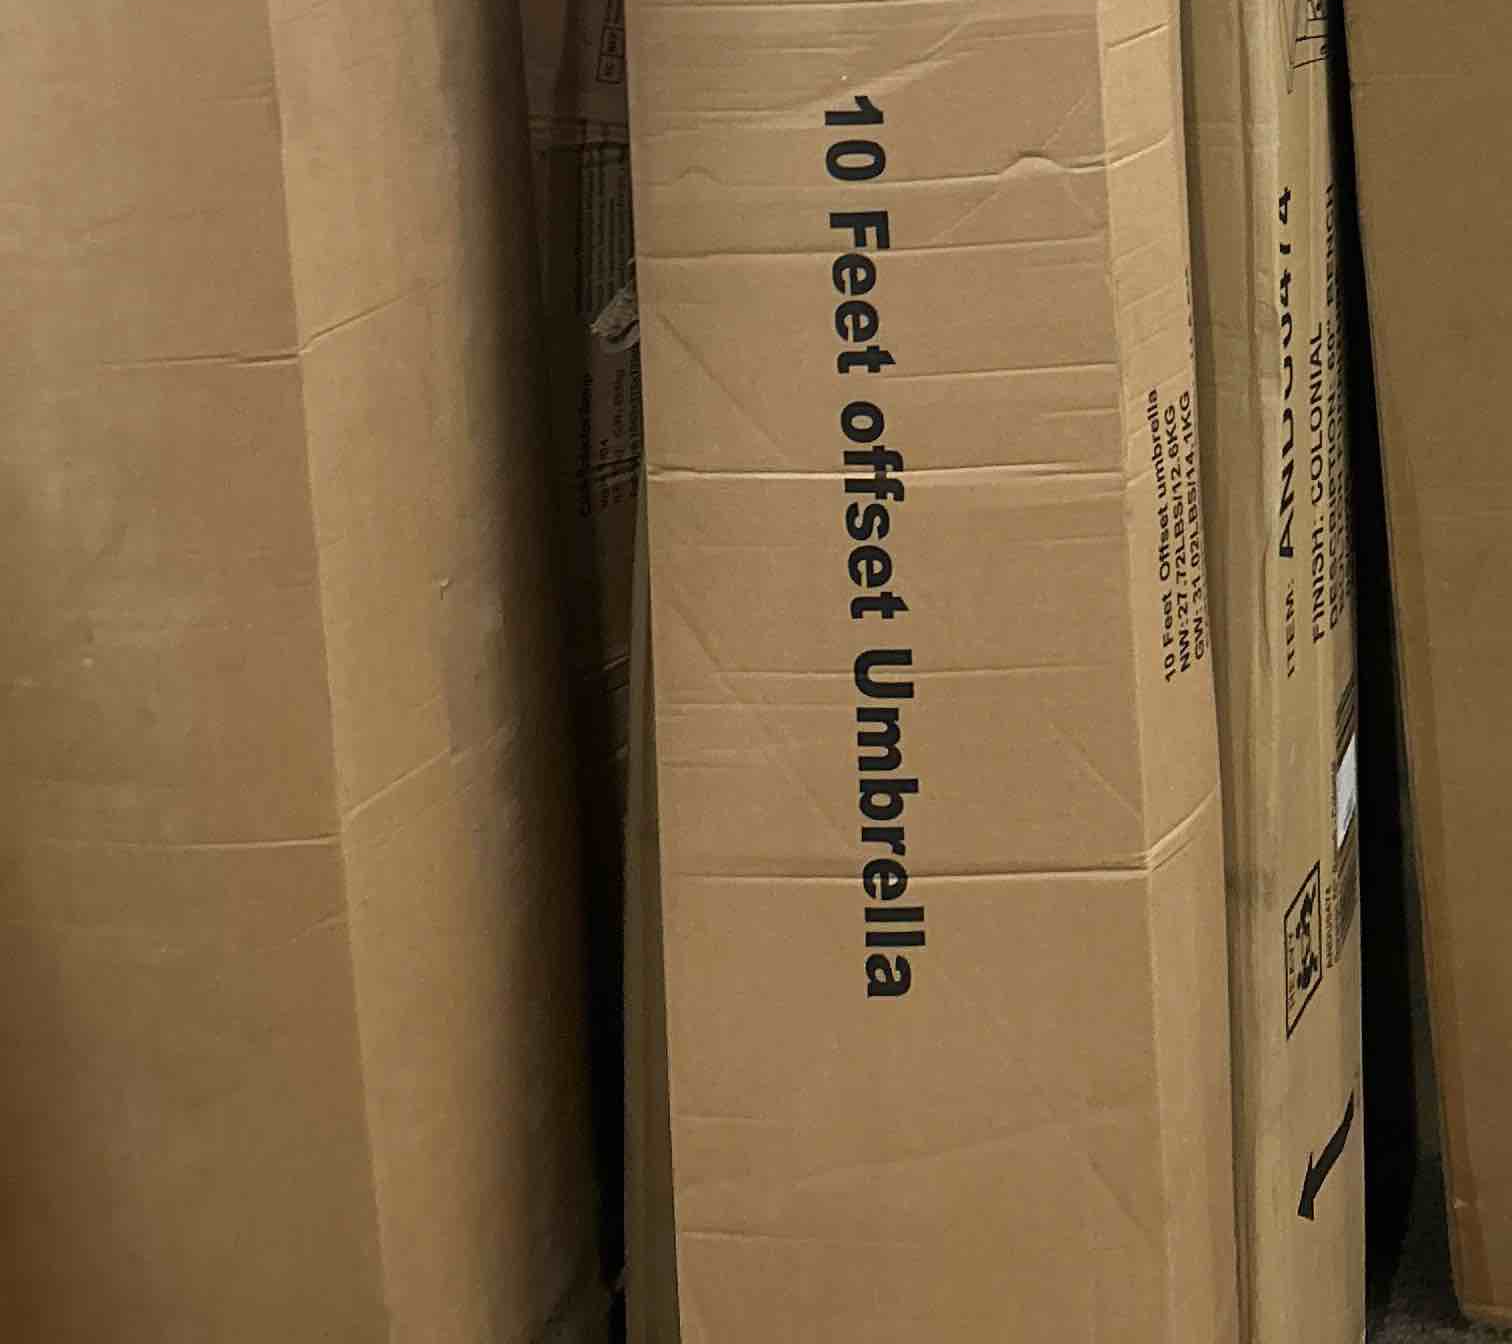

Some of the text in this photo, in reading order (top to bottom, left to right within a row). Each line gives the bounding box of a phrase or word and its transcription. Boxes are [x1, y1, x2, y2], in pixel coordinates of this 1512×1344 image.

[1147, 388, 1167, 499] umbrella
[1309, 321, 1324, 506] COLONIAL
[824, 94, 926, 1000] 10 Feet offset Umbrella
[1157, 502, 1171, 581] Offset
[1161, 591, 1174, 647] Feet
